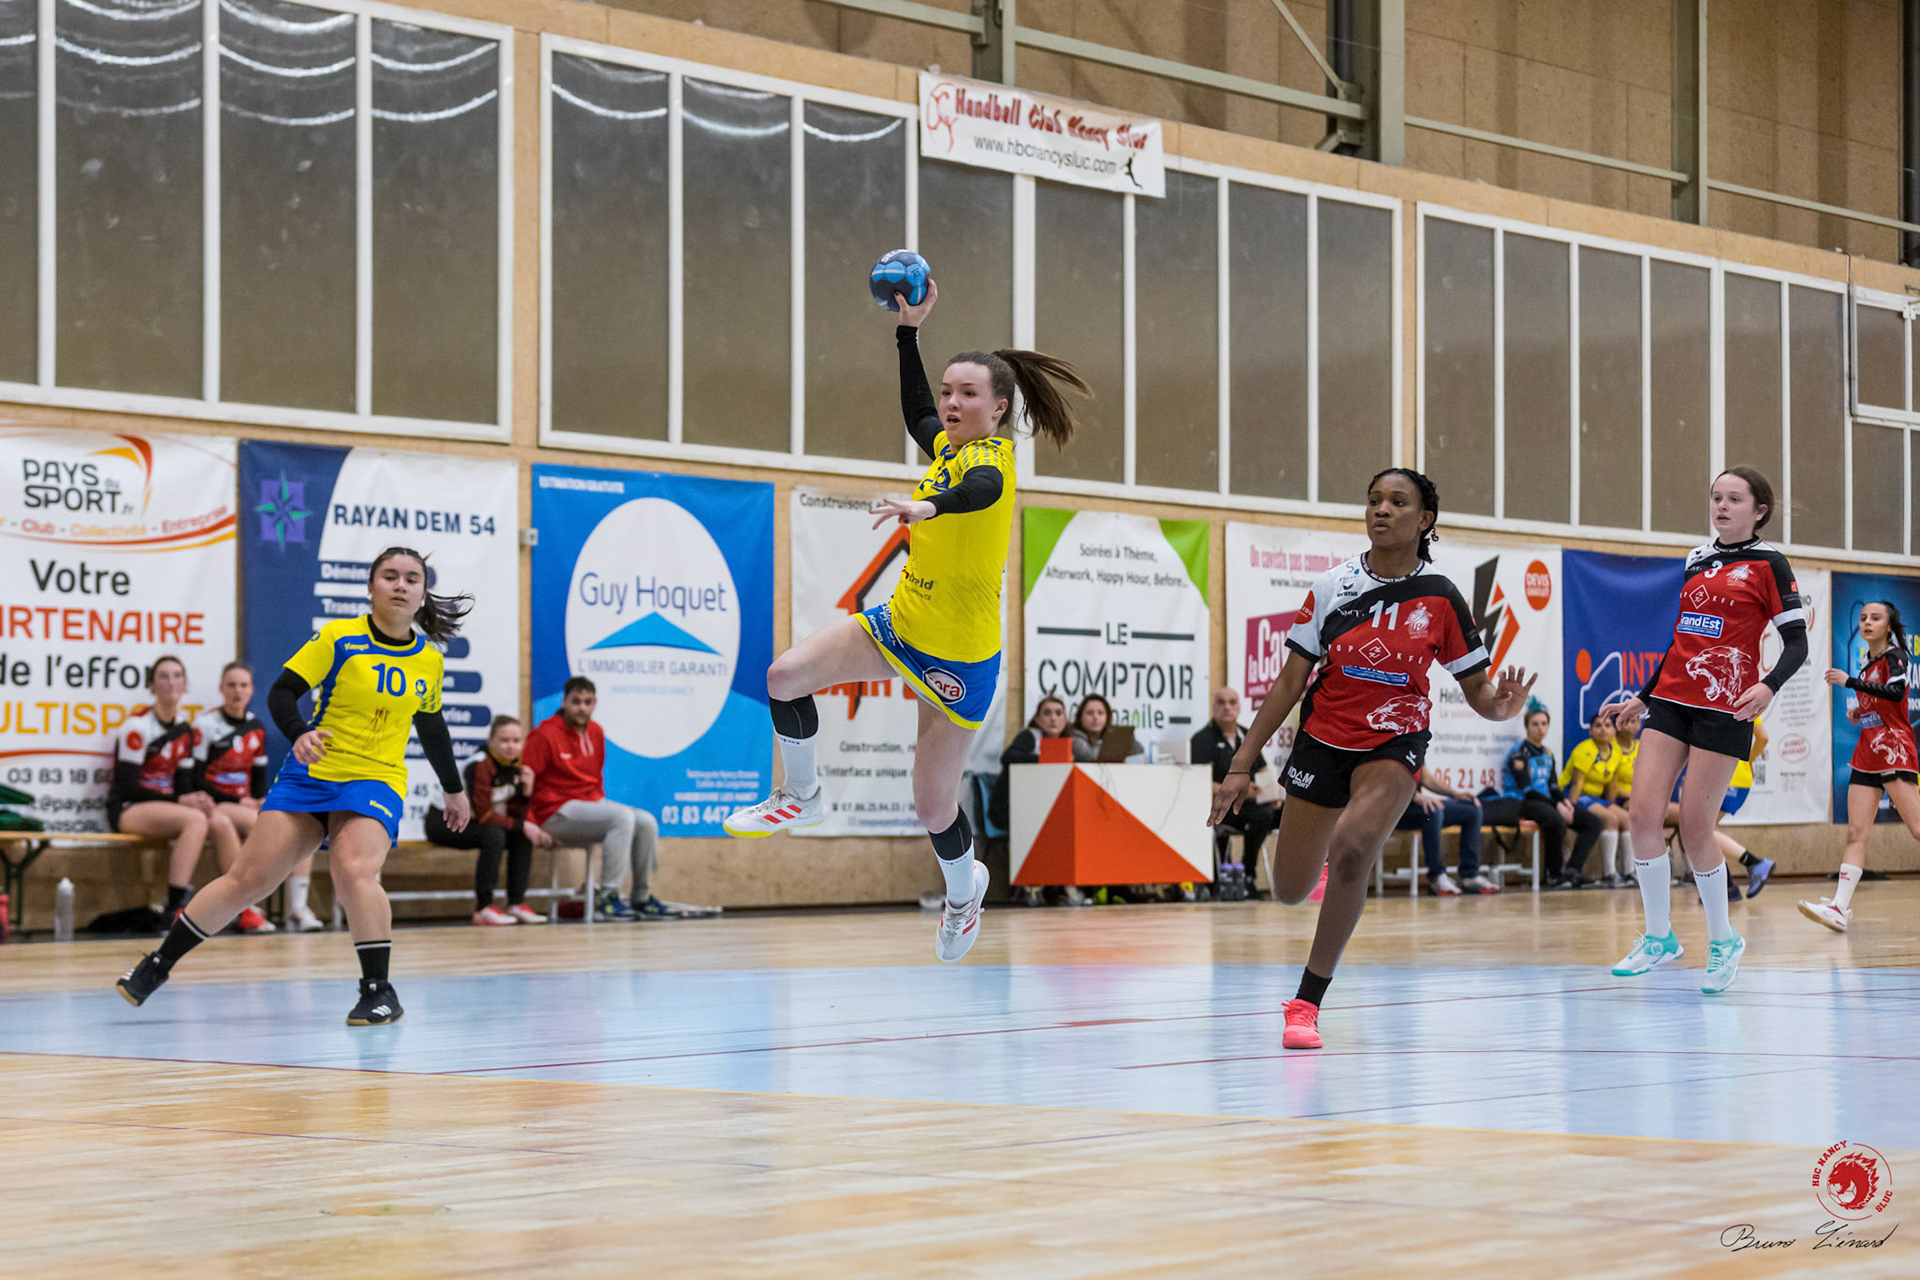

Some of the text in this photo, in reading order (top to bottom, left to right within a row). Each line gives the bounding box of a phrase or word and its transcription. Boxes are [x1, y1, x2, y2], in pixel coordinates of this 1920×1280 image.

[955, 88, 1021, 125] Handball
[974, 134, 1117, 174] www.hbcnancysluc.com
[22, 458, 99, 487] PAYS
[23, 485, 121, 513] SPORT
[799, 493, 872, 511] Construisons
[21, 518, 56, 536] Club
[334, 504, 496, 536] RAYAN DEM 54
[1123, 546, 1158, 563] Thème,
[29, 558, 130, 596] Votre
[1044, 566, 1094, 583] Afterwork,
[1096, 570, 1124, 586] Happy
[1126, 572, 1151, 587] Hour,
[1526, 573, 1550, 588] DEVIS
[1704, 560, 1723, 579] 3
[579, 572, 728, 617] Guy Hoquet
[1368, 600, 1400, 631] 11
[1106, 622, 1128, 645] LE
[1258, 619, 1293, 684] Cav
[577, 658, 728, 676] L'IMMOBILIER GARANTI
[371, 662, 407, 698] 10
[927, 676, 960, 698] ora
[1038, 659, 1194, 700] COMPTOIR
[0, 701, 204, 736] ULTISPT
[1277, 727, 1293, 749] 83
[7, 768, 32, 784] 03
[39, 768, 62, 784] 83
[1434, 767, 1496, 789] 06 21 48
[661, 805, 679, 824] 03
[681, 805, 700, 824] 83
[702, 805, 730, 824] 447
